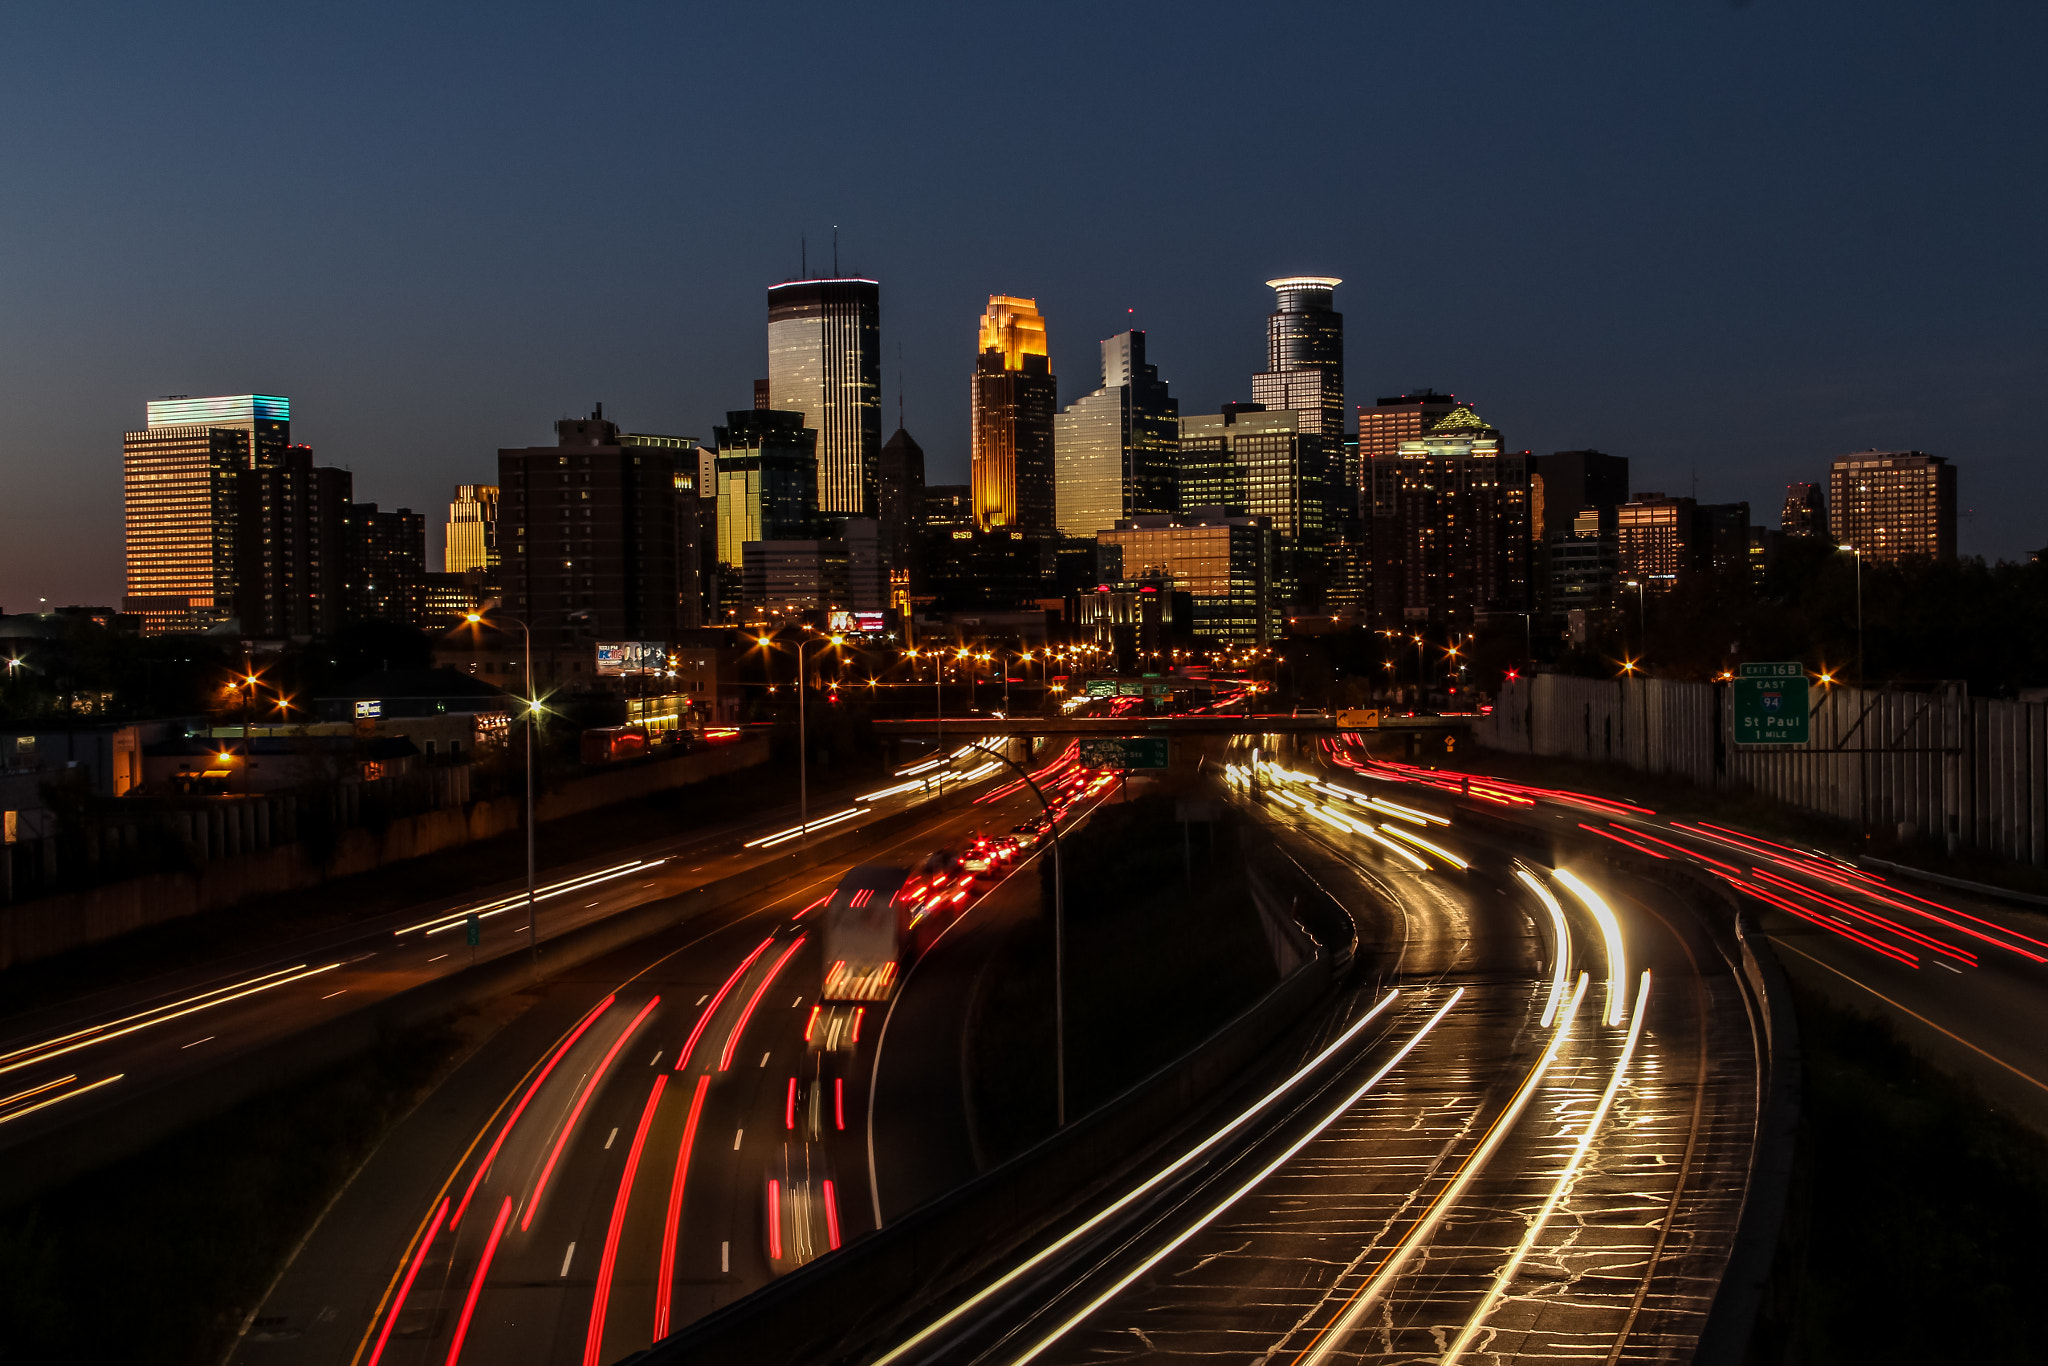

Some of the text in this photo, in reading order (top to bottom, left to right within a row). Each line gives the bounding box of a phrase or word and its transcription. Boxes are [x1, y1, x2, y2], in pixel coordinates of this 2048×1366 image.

[1746, 665, 1797, 675] EXIT 16B
[1756, 680, 1786, 689] EAST
[1763, 697, 1779, 707] 94
[1744, 716, 1800, 727] St Paul
[1756, 730, 1761, 740] 1
